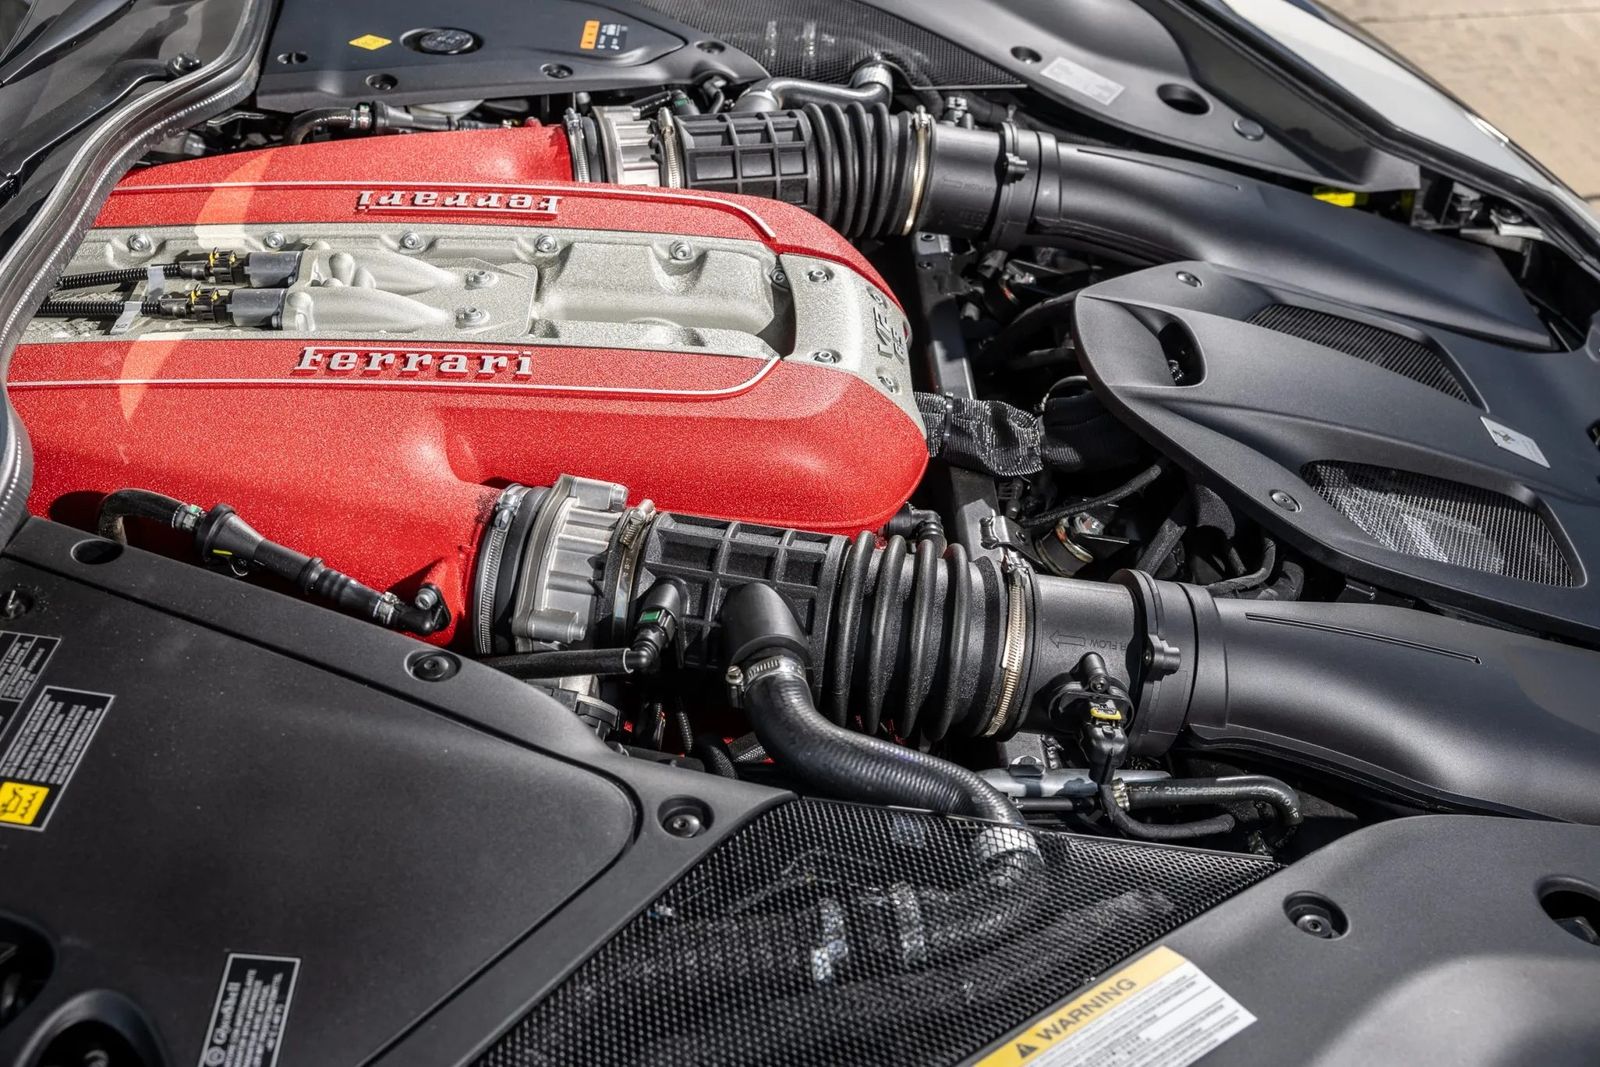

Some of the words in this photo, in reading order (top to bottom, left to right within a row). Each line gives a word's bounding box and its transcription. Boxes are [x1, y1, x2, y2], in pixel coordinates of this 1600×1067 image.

[357, 190, 562, 214] Ferrari
[294, 346, 532, 376] Ferrari
[1089, 639, 1118, 651] FLOW
[1035, 978, 1137, 1041] WARNING
